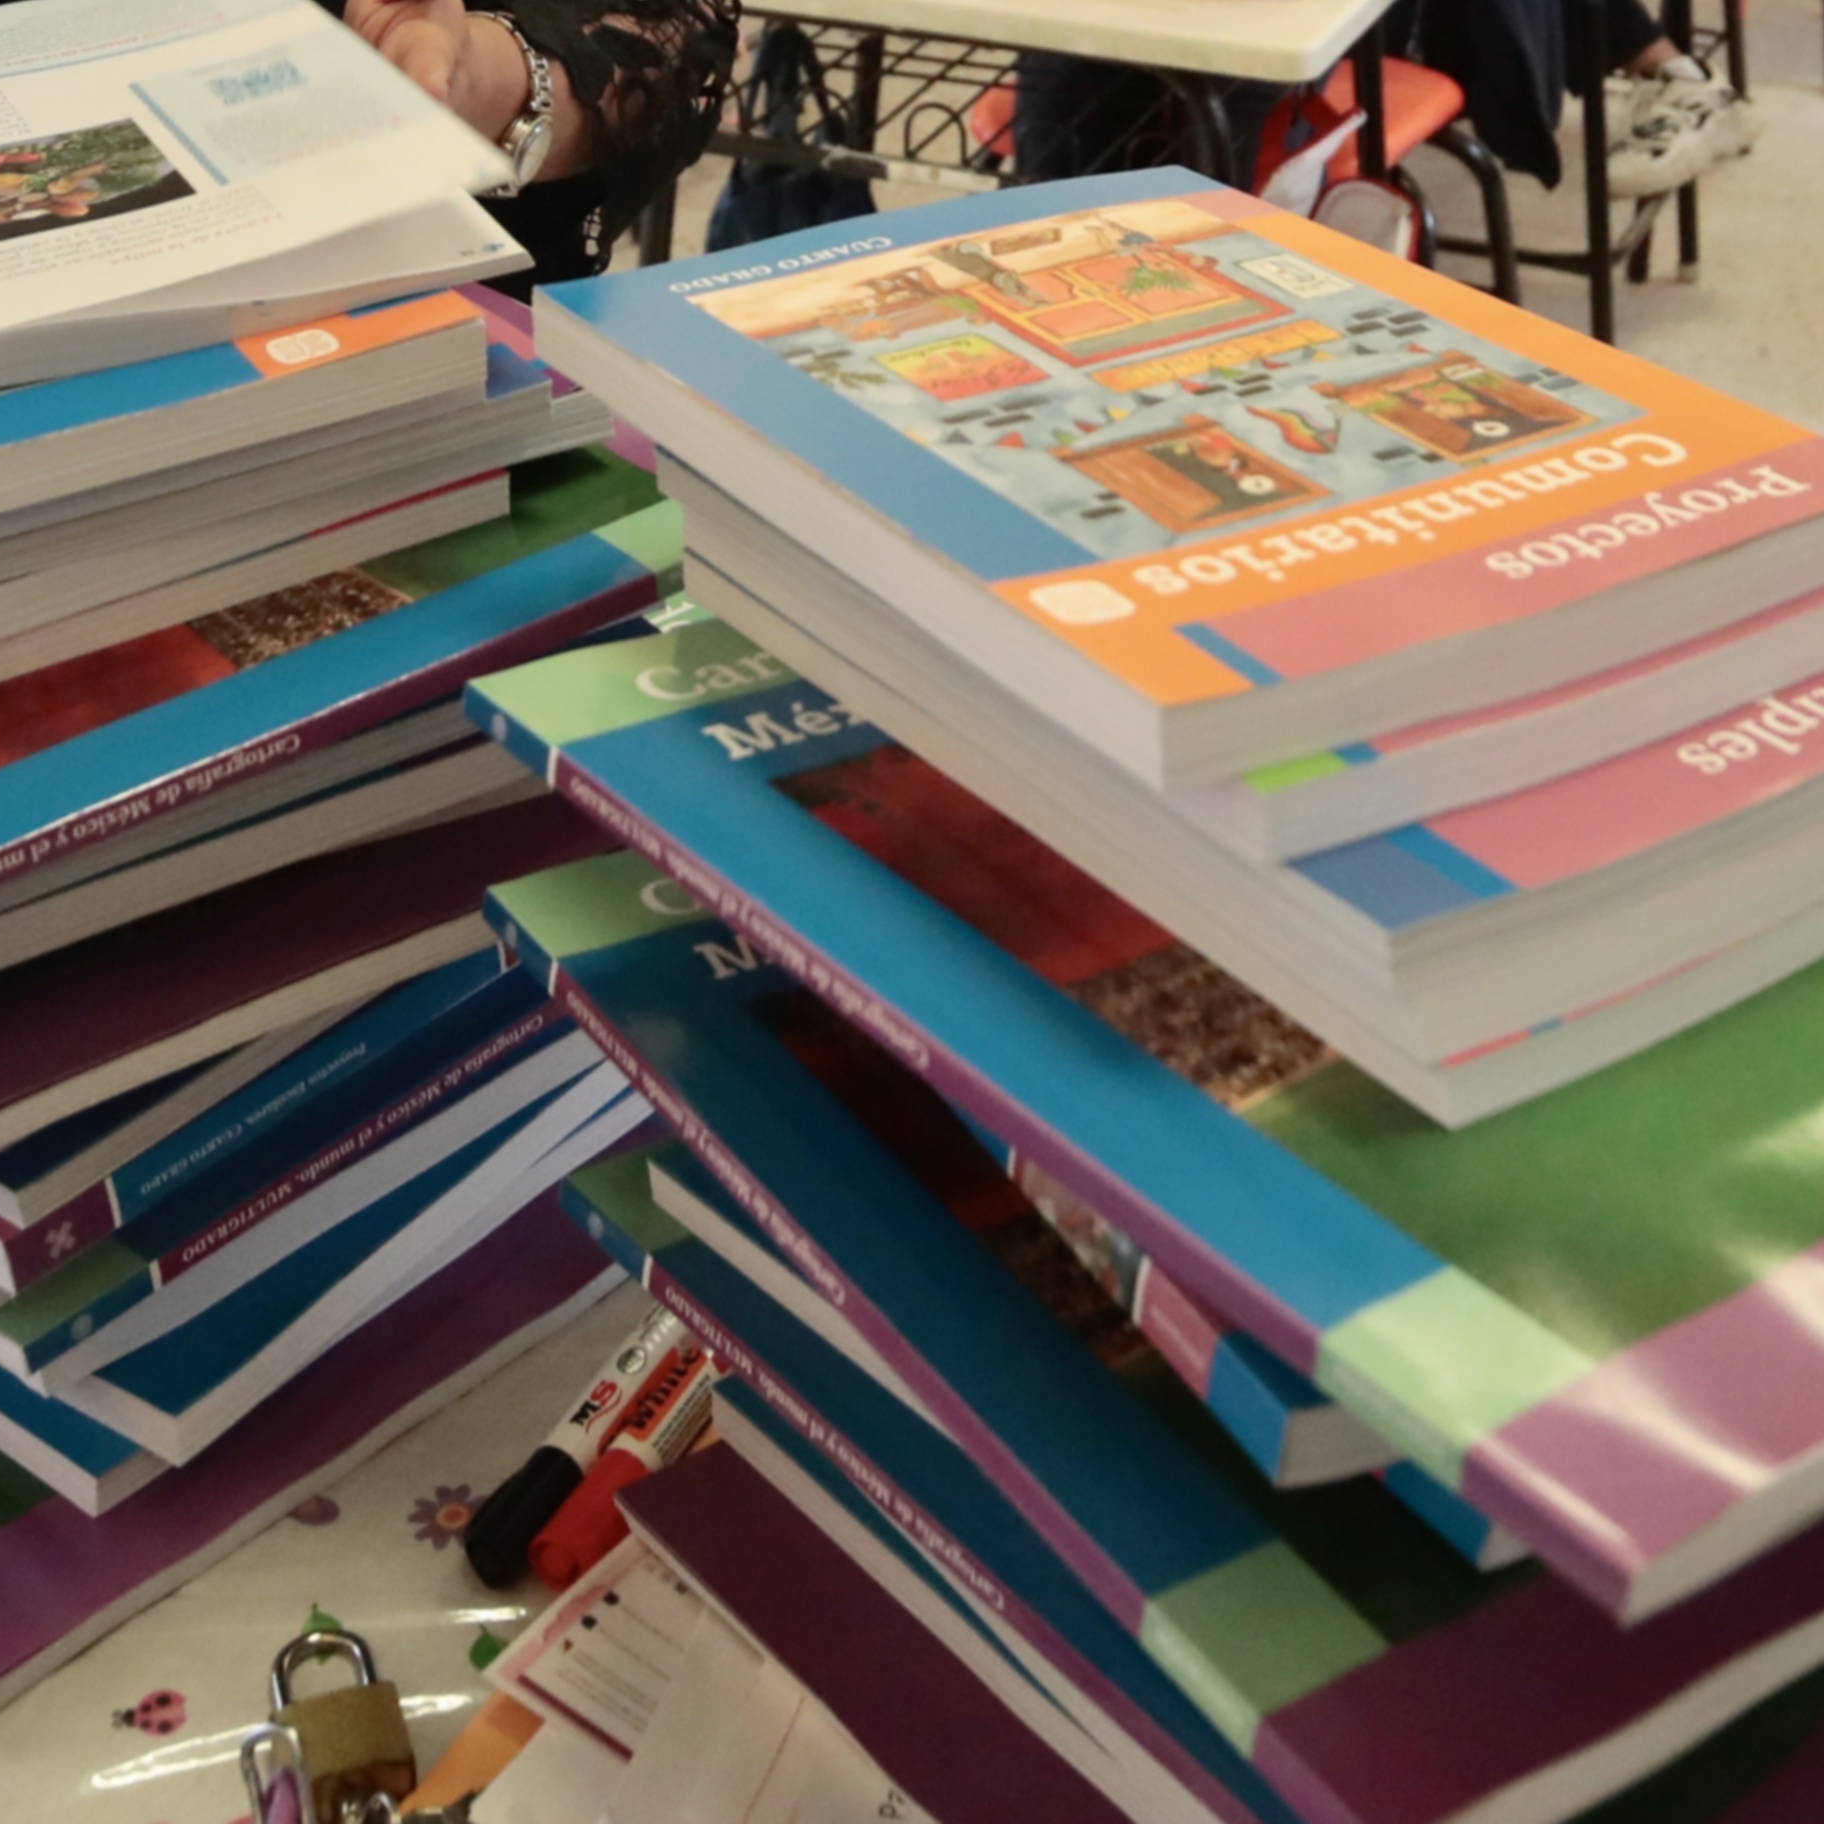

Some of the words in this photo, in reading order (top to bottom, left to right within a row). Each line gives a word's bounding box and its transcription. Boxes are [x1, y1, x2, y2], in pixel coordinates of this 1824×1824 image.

[776, 235, 894, 272] CUARTO
[668, 263, 773, 294] GRADO
[1131, 430, 1690, 597] Comunitarios
[1484, 462, 1813, 581] Proyectos
[184, 732, 302, 796] Cartografía
[155, 783, 181, 809] de
[54, 822, 74, 852] y
[71, 798, 153, 842] México
[32, 835, 52, 864] el
[441, 1062, 463, 1090] de
[387, 1082, 443, 1126] México
[357, 1124, 374, 1149] el
[294, 1136, 357, 1183] mundo.
[181, 1181, 293, 1263] MULTIGRADO
[569, 1378, 619, 1427] MS
